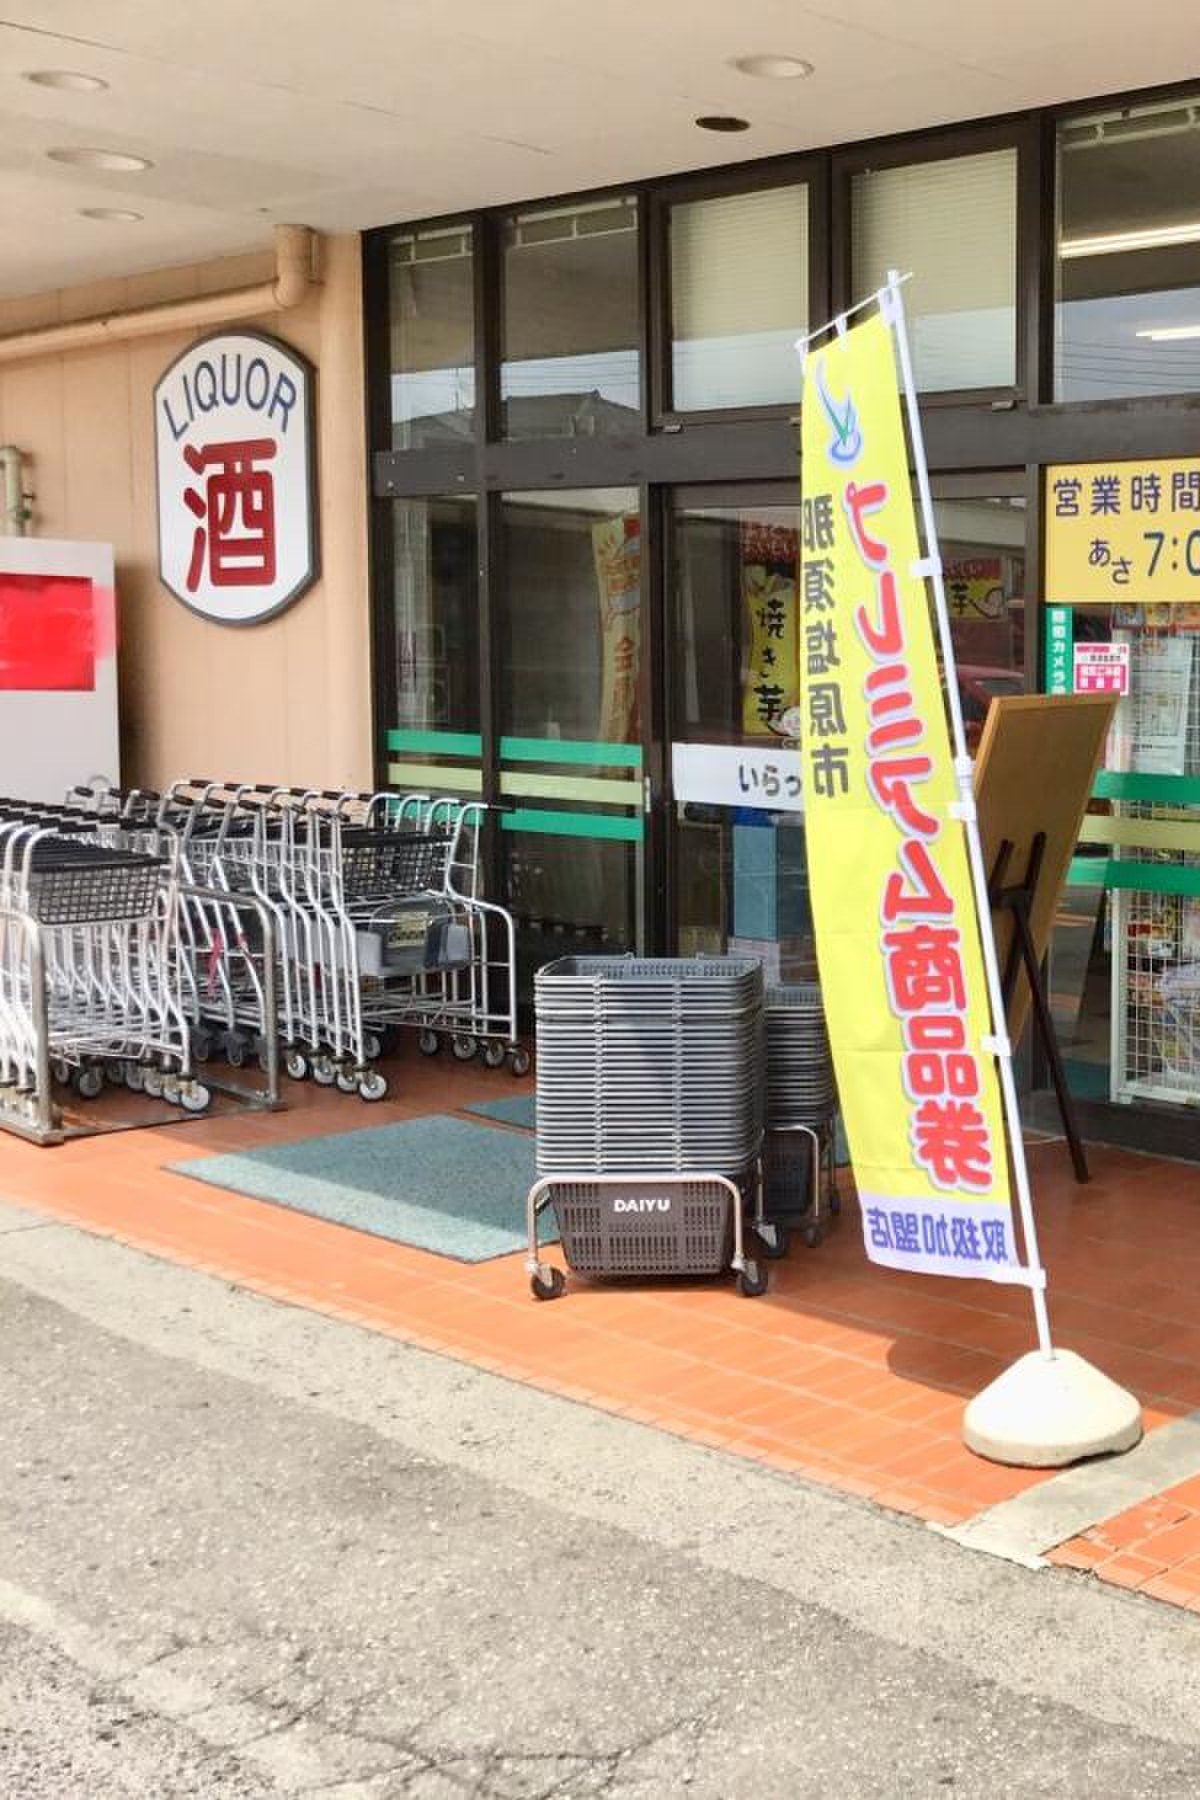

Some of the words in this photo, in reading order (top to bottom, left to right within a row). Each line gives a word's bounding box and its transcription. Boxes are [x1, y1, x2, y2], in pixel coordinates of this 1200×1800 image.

[163, 353, 297, 440] LIQUOR
[184, 438, 276, 593] 酒
[613, 1198, 672, 1213] DAIYU
